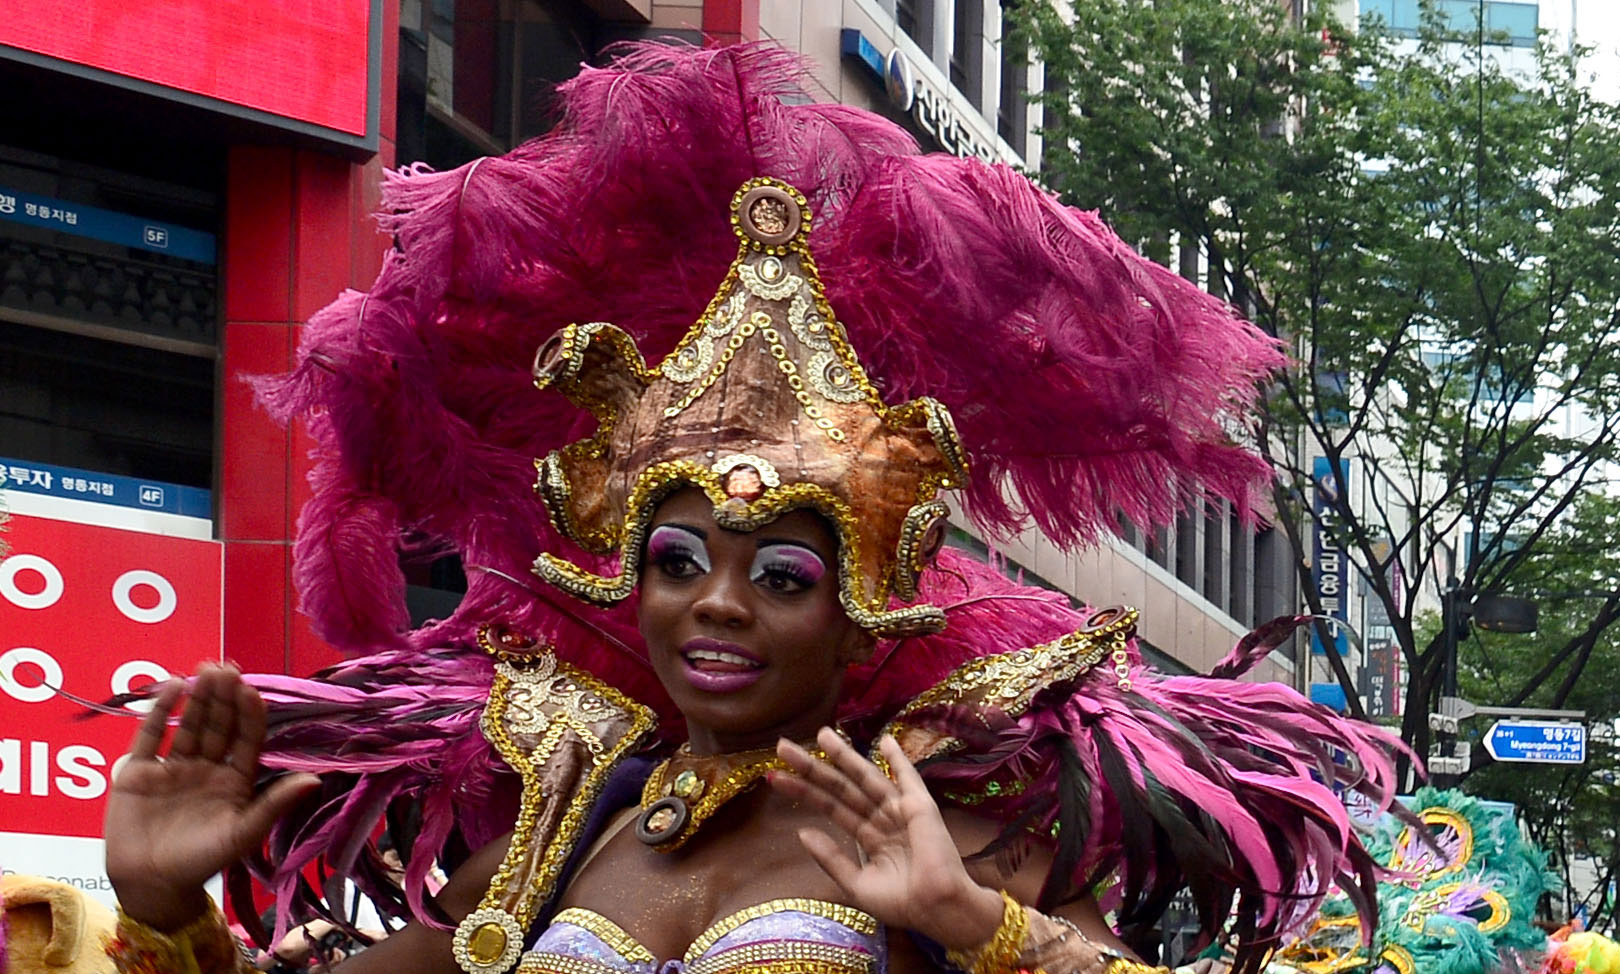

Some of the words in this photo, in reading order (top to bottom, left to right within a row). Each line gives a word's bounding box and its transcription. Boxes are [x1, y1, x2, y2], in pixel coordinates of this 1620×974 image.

[25, 203, 78, 225] 명동지점
[147, 230, 166, 242] 5F
[0, 464, 54, 489] 투자
[61, 477, 115, 496] 명동지점
[142, 490, 161, 502] 4F
